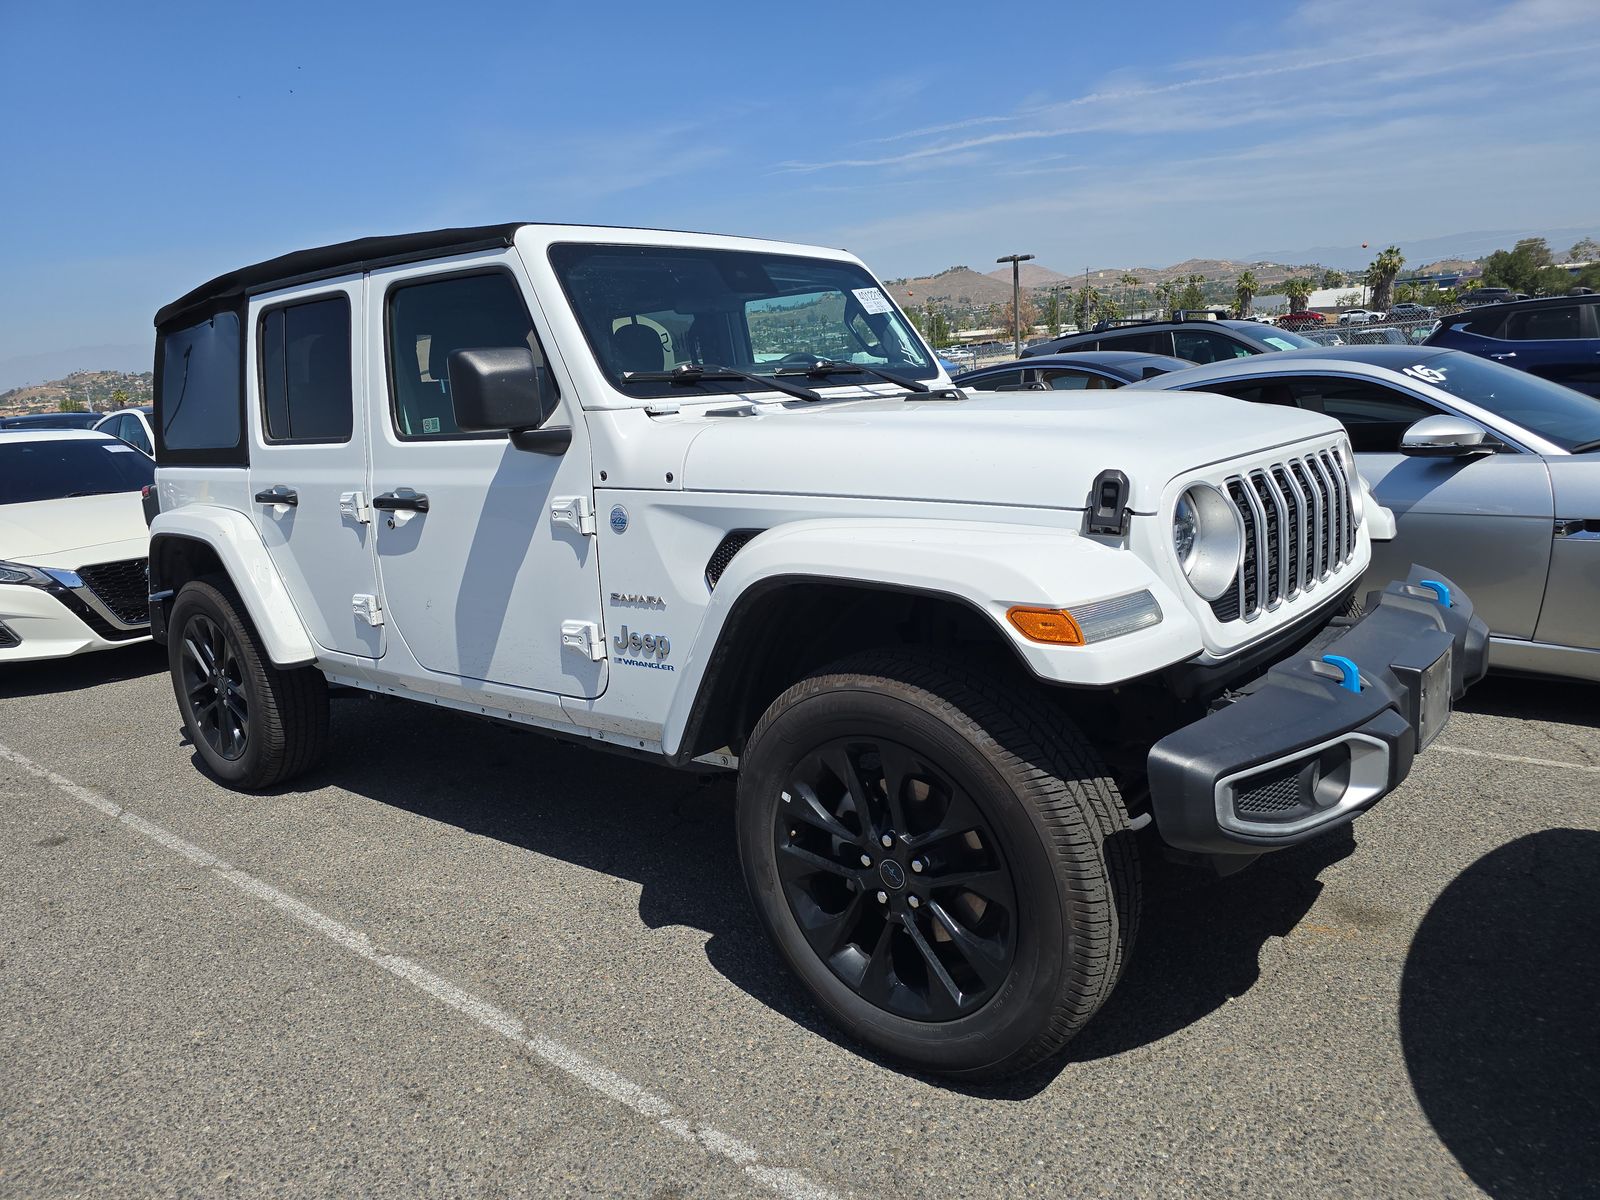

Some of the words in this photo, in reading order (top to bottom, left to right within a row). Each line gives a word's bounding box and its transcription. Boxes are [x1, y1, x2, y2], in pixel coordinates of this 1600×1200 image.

[610, 592, 667, 606] SAHARA
[613, 625, 671, 660] Jeep
[623, 658, 674, 671] WRANGLER
